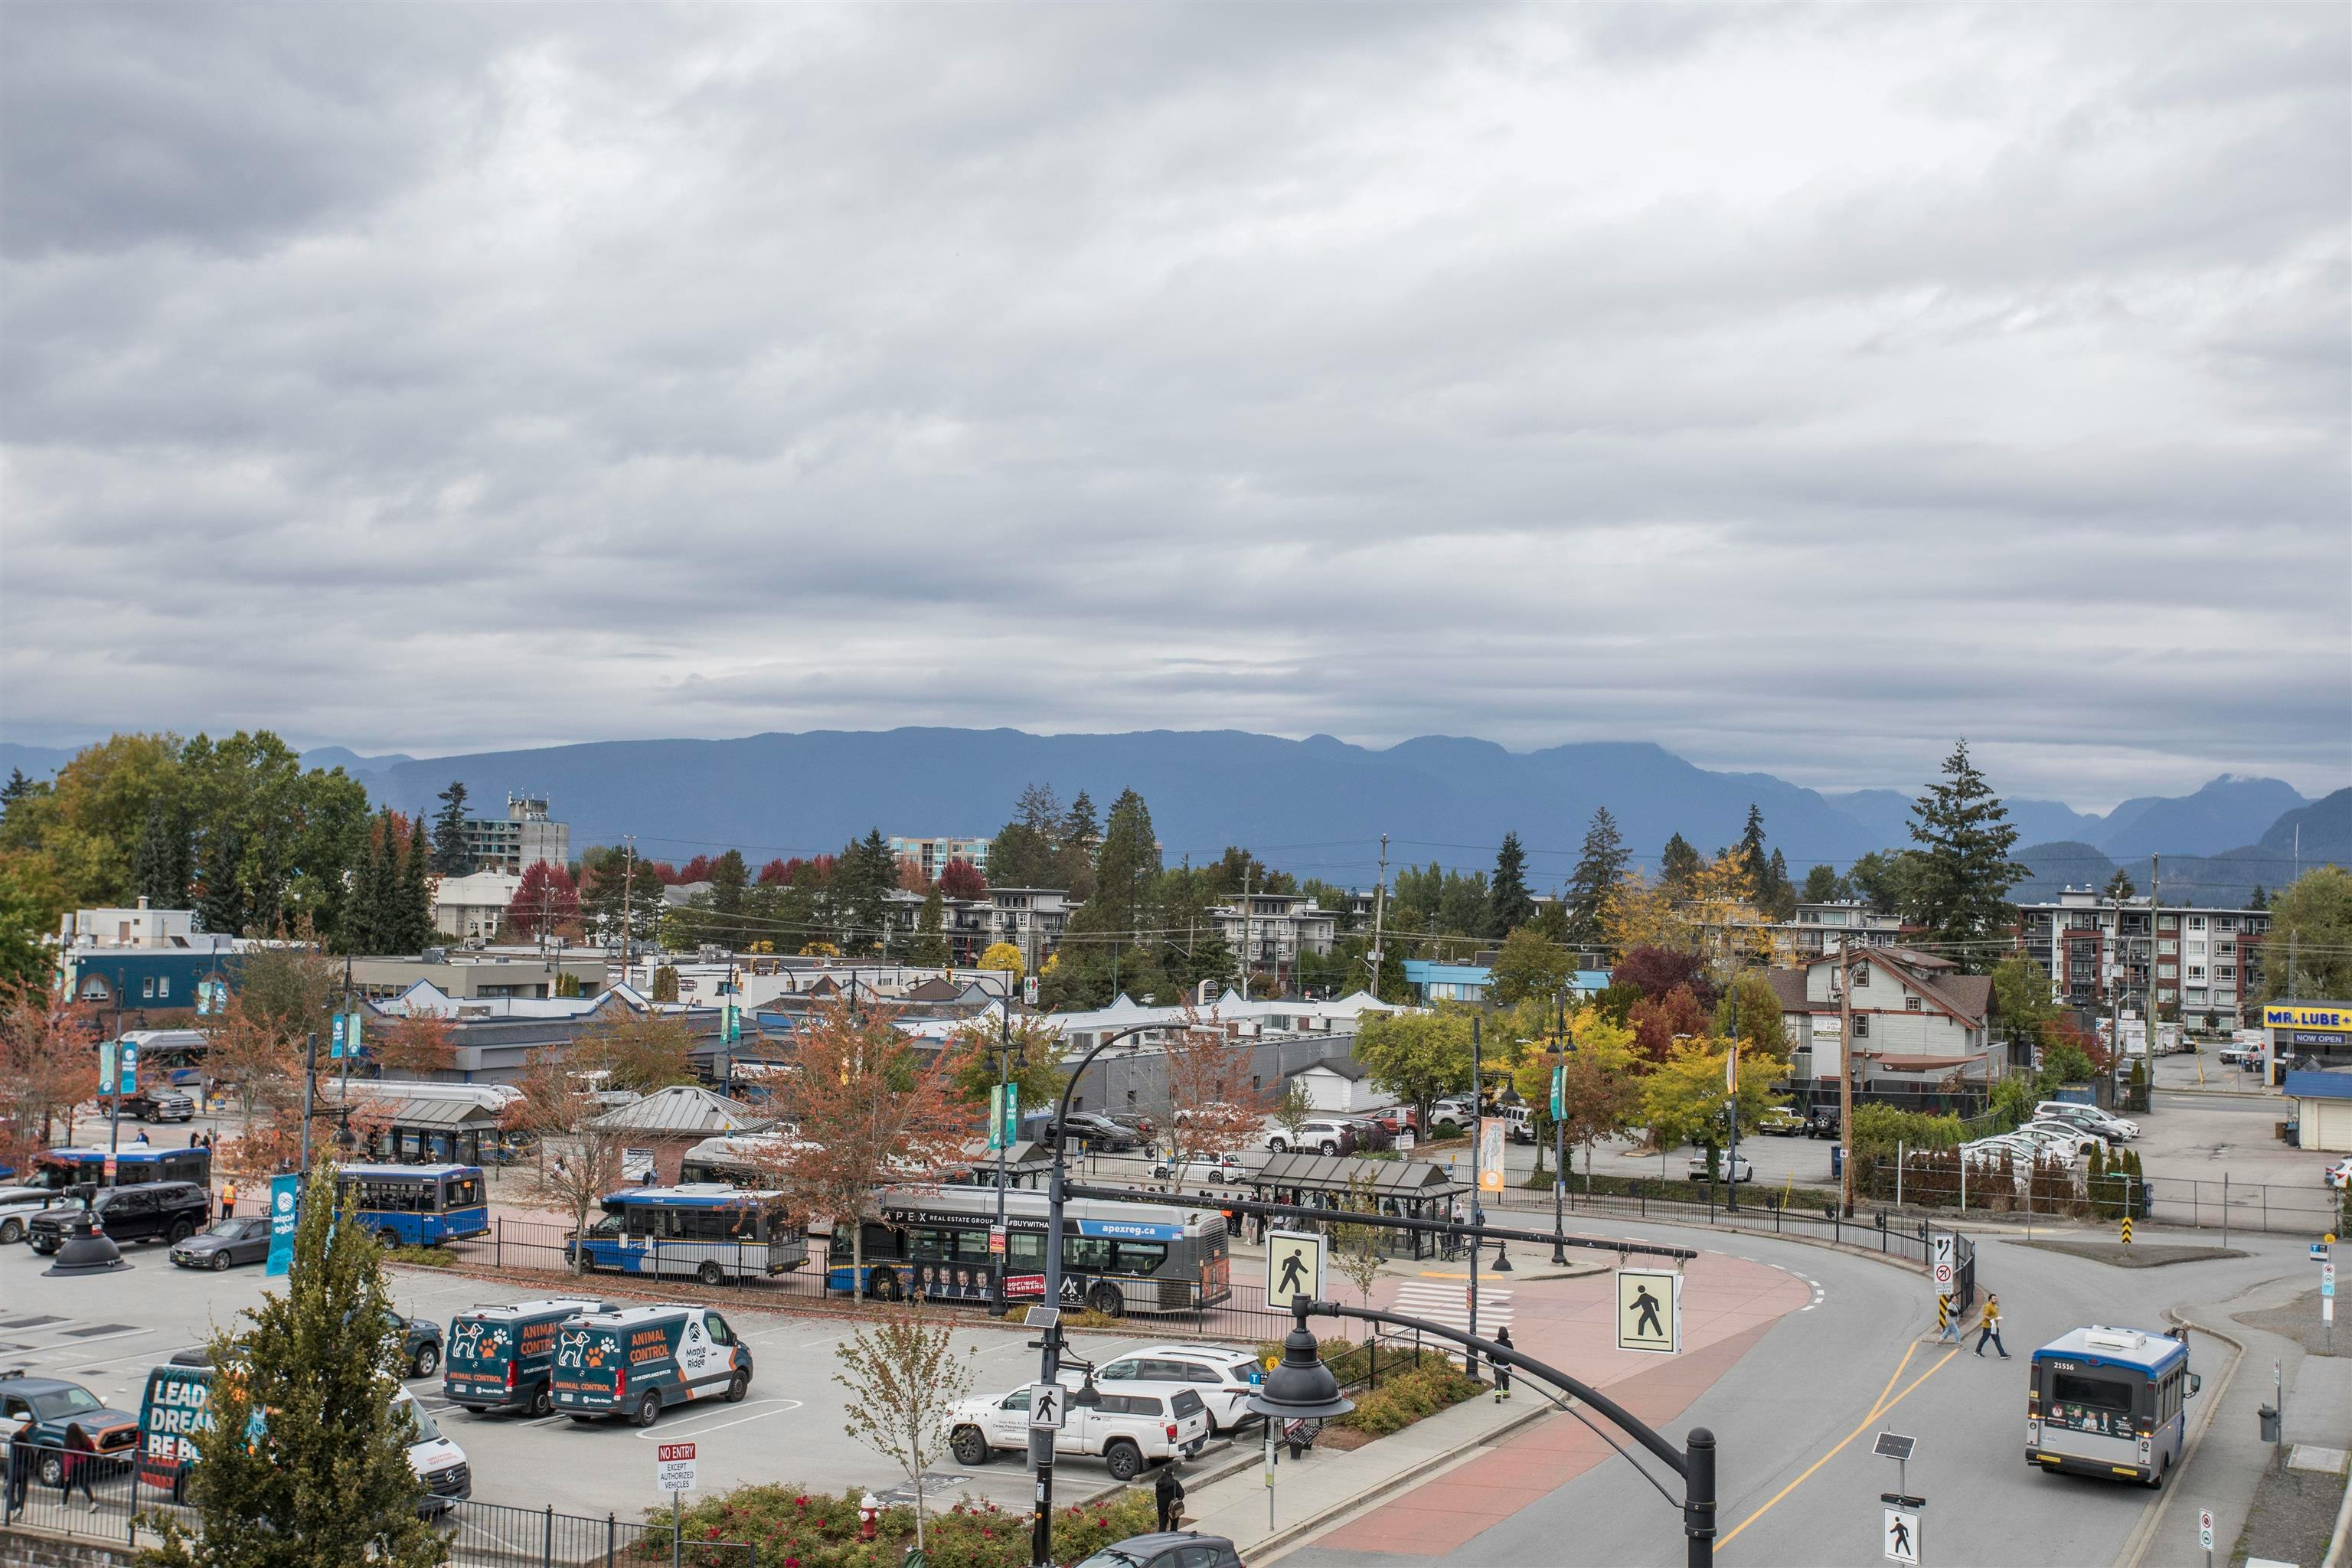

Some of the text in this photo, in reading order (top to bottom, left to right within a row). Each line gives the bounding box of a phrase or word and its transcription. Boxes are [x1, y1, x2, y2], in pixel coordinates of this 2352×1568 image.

[2267, 1011, 2298, 1024] MR.
[2301, 1012, 2340, 1026] LUBE
[1008, 1219, 1049, 1229] #BUYWITHA
[1102, 1224, 1156, 1235] apexreg.ca
[632, 1328, 666, 1347] ANIMAL
[629, 1344, 670, 1363] CONTROL
[686, 1345, 707, 1357] Maple
[688, 1357, 705, 1369] Ridge
[2053, 1361, 2075, 1370] 21516
[449, 1371, 503, 1383] ANIMAL CONTROL
[642, 1371, 659, 1380] COMPLIANCE
[1251, 1374, 1258, 1383] T
[556, 1381, 611, 1392] ANIMAL CONTROL
[152, 1380, 207, 1409] LEAD
[148, 1433, 176, 1460] BE
[660, 1445, 694, 1459] NO ENTRY
[667, 1462, 687, 1472] EXCEPT
[660, 1471, 694, 1481] AUTHORIZED
[665, 1480, 690, 1489] VEHICLES
